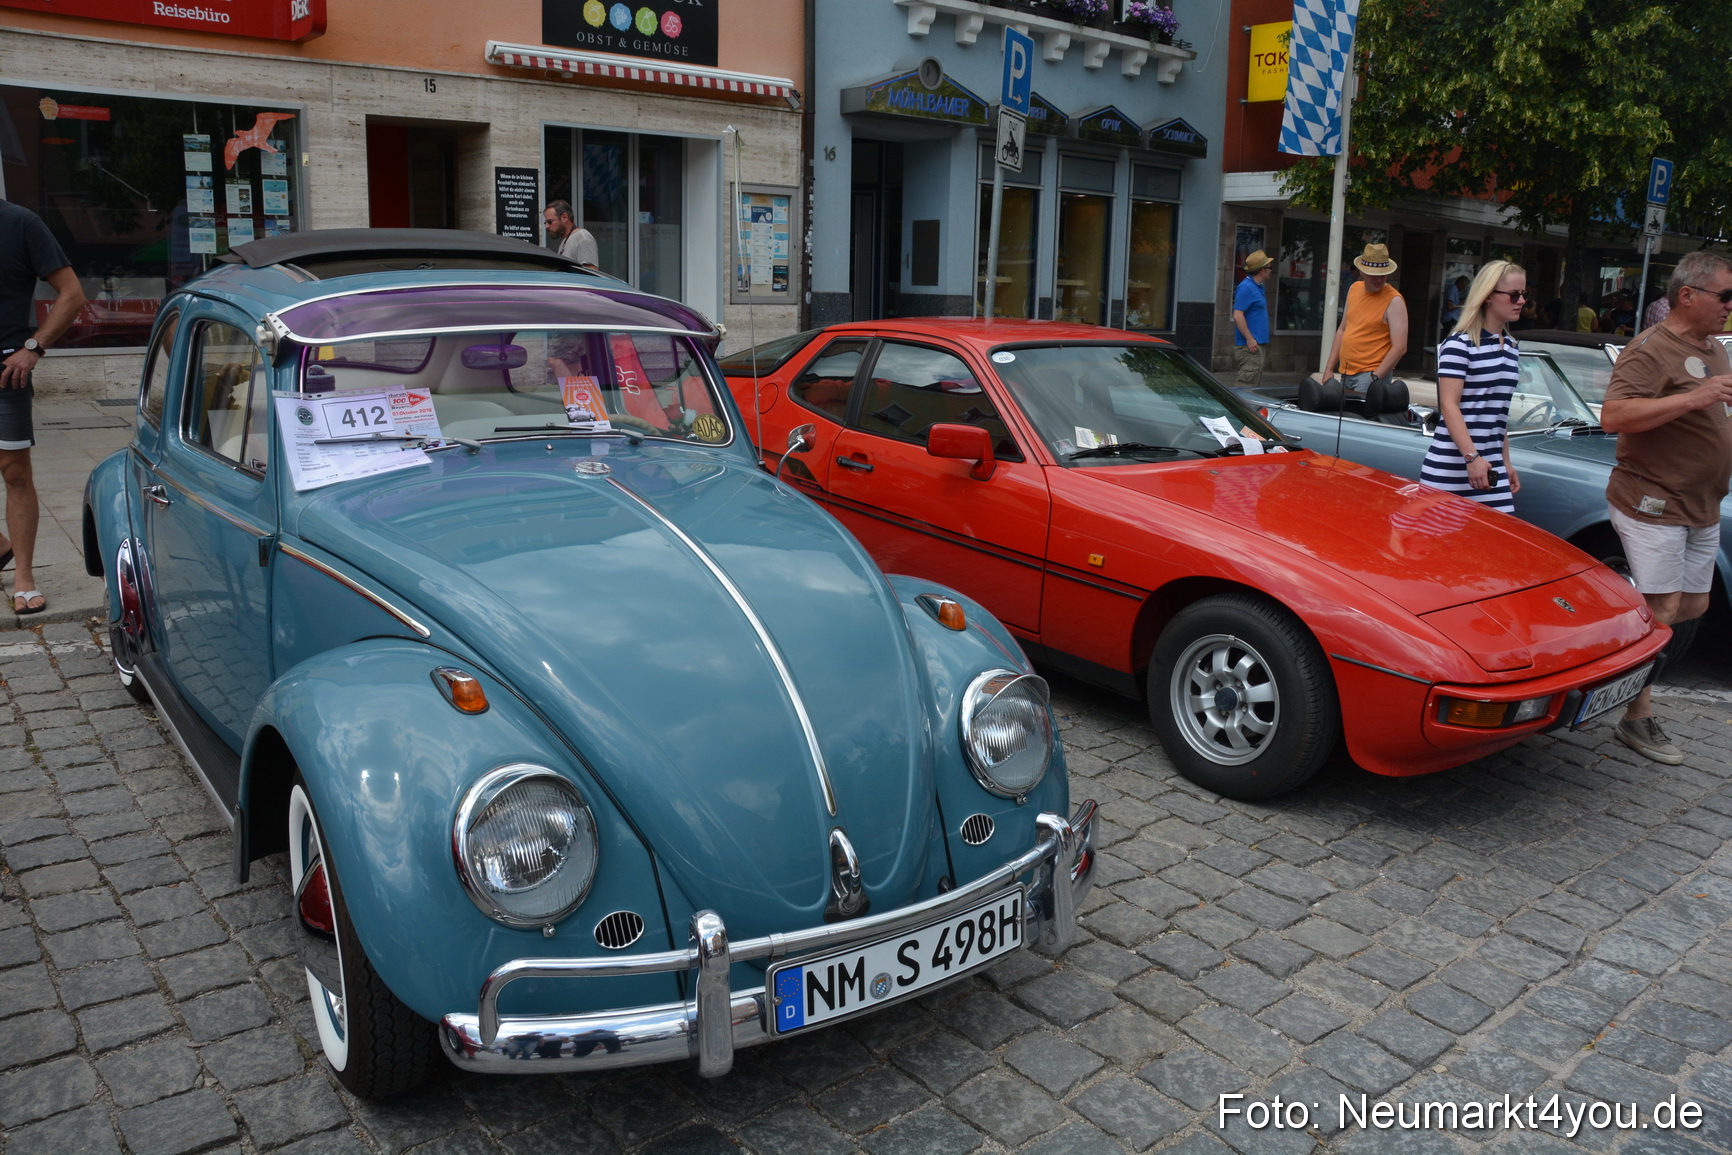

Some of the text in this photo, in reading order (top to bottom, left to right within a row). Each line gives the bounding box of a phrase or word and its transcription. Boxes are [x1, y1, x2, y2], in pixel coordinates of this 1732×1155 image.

[153, 1, 230, 24] Reisebüro
[576, 31, 689, 56] OBST & GEMÜSE
[1009, 40, 1026, 98] P
[1254, 51, 1288, 67] TaK
[424, 77, 436, 93] 15
[887, 86, 970, 118] MÜHLBAUER
[1008, 120, 1018, 130] nur
[1102, 118, 1122, 132] OPTIK
[1163, 128, 1196, 143] SCHMUCK
[824, 144, 836, 162] 16
[1653, 164, 1667, 197] P
[342, 405, 388, 428] 412
[696, 417, 722, 438] ADAC
[806, 898, 1018, 1017] NM S 498H
[785, 1005, 796, 1019] D
